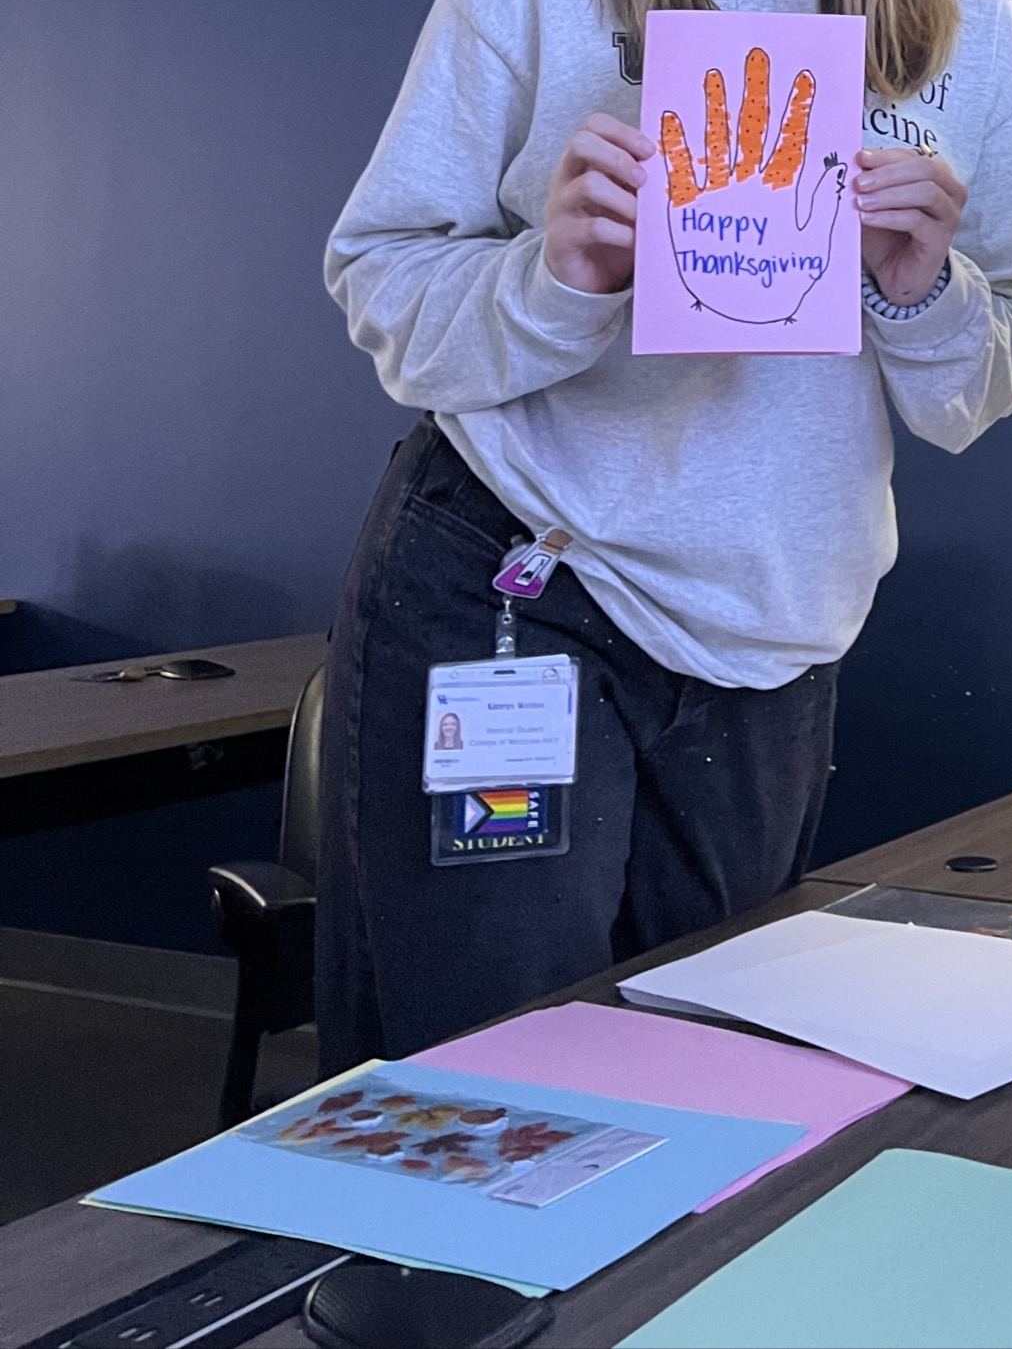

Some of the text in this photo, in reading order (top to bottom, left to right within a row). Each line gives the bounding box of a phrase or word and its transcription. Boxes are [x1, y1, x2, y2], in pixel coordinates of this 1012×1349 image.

[919, 72, 953, 112] of
[681, 207, 768, 246] Happy
[675, 249, 825, 289] Thanksgiving
[452, 834, 544, 850] STUDENT
